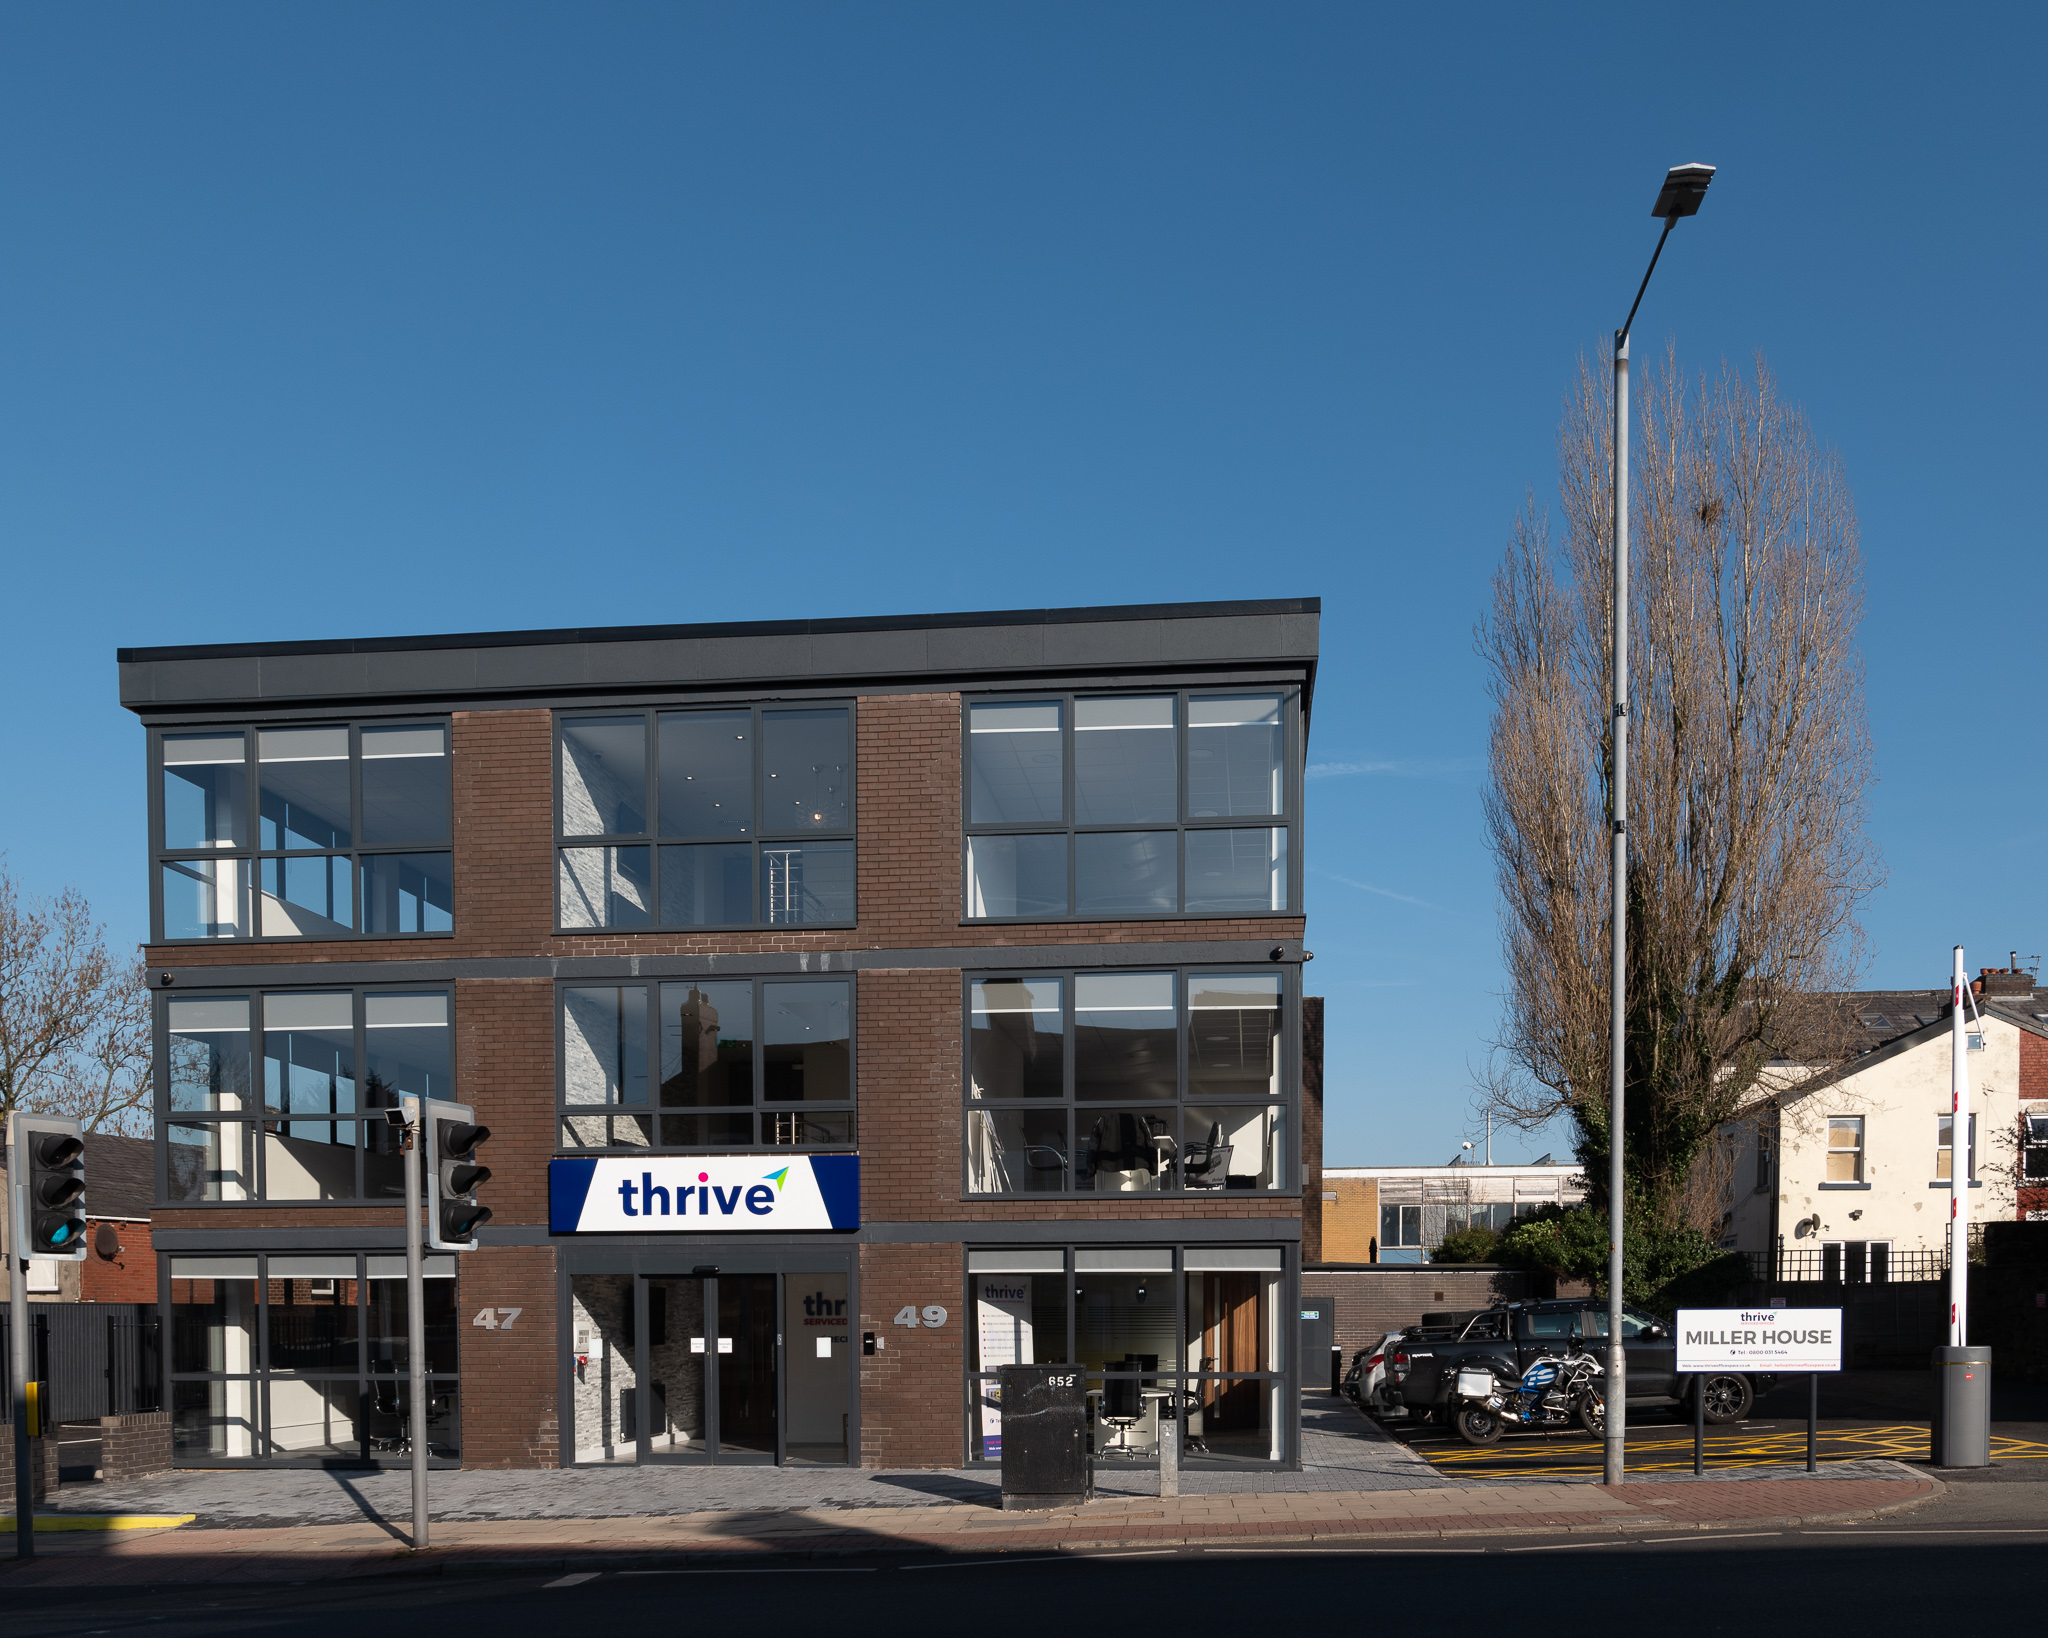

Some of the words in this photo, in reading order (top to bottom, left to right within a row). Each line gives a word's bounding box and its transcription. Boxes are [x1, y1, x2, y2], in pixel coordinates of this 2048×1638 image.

[618, 1172, 775, 1216] thrive
[985, 1284, 1024, 1299] thrive
[803, 1292, 847, 1316] thr
[473, 1308, 522, 1330] 47
[803, 1318, 847, 1326] SERVICED
[893, 1305, 948, 1329] 49
[1740, 1312, 1775, 1322] thrive
[1686, 1330, 1756, 1345] MILLER
[1762, 1329, 1832, 1345] HOUSE
[1048, 1376, 1074, 1387] 652
